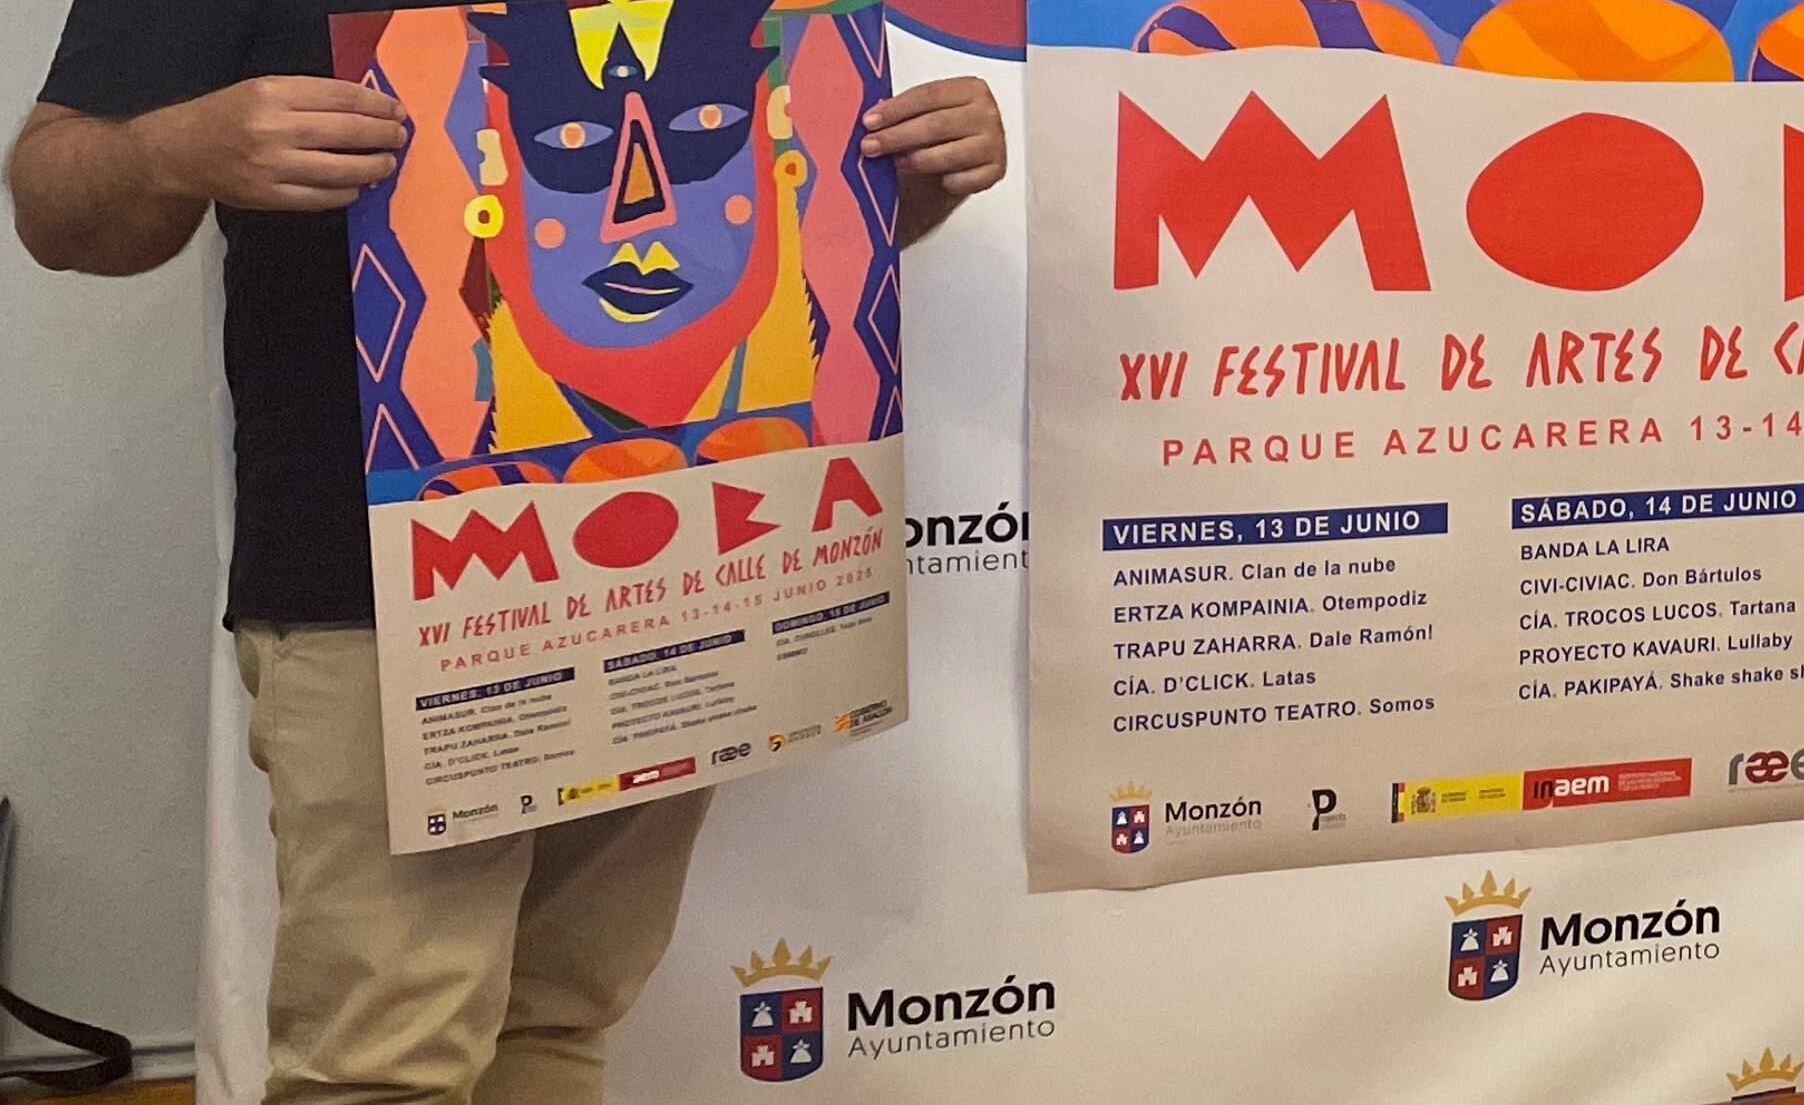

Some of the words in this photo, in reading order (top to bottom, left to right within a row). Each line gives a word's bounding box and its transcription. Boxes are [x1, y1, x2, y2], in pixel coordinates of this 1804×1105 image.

[1120, 351, 1188, 401] XVI
[1212, 337, 1406, 398] FESTIVAL
[1441, 334, 1492, 391] DE
[1526, 327, 1662, 388] ARTES
[1700, 326, 1748, 381] DE
[1163, 431, 1354, 467] PARQUE
[1383, 417, 1662, 456] AZUCARERA
[1521, 498, 1633, 523] SÁBADO,
[1646, 496, 1671, 515] 14
[1682, 494, 1713, 514] DE
[1723, 489, 1796, 512] JUNIO
[905, 501, 1029, 548] onzó
[1113, 520, 1242, 545] VIERNES,
[1256, 519, 1283, 538] 13
[1296, 516, 1329, 536] DE
[1340, 510, 1419, 534] JUNIO
[1521, 541, 1589, 560] BANDA
[1595, 539, 1619, 556] LA
[1626, 537, 1669, 554] LIRA
[419, 622, 451, 647] XVI
[462, 601, 552, 640] FESTIVAL
[567, 593, 591, 620] DE
[605, 577, 667, 613] ARTES
[683, 570, 705, 596] DE
[715, 554, 766, 587] CALLE
[782, 548, 803, 575] DE
[812, 528, 883, 567] MONZÓN
[1113, 565, 1233, 586] ANIMASUR.
[1242, 563, 1286, 580] Clan
[1294, 561, 1317, 578] de
[1325, 560, 1340, 576] la
[1349, 557, 1395, 574] nube
[1520, 573, 1635, 595] CIVI-CIVIAC.
[1643, 572, 1678, 587] Don
[1685, 567, 1761, 584] Bártulos
[1114, 604, 1184, 623] ERTZA
[1191, 597, 1314, 619] KOMPAINIA.
[1322, 590, 1427, 612] Otempodiz
[1520, 609, 1557, 630] CÍA.
[1565, 607, 1645, 627] TROCOS
[1653, 602, 1722, 621] LUCOS.
[1730, 600, 1795, 616] Tartana
[1113, 640, 1185, 660] TRAPU
[1193, 634, 1301, 655] ZAHARRA.
[1310, 631, 1352, 648] Dale
[1360, 624, 1432, 645] Ramón!
[1520, 642, 1626, 665] PROYECTO
[1633, 636, 1720, 657] KAVAURI.
[1728, 632, 1792, 651] Lullaby
[1113, 675, 1155, 696] CÍA.
[1164, 672, 1254, 693] D'CLICK.
[1263, 671, 1316, 687] Latas
[1519, 679, 1556, 700] CÍA.
[1564, 671, 1662, 697] PAKIPAYÁ.
[1670, 671, 1724, 688] Shake
[1731, 667, 1783, 684] shake
[1113, 707, 1266, 732] CIRCUSPUNTO
[1274, 700, 1361, 721] TEATRO.
[1369, 698, 1434, 714] Somos
[1533, 775, 1610, 800] inaem
[1165, 796, 1262, 822] Monzón
[1540, 902, 1720, 950] Monzón
[1539, 941, 1720, 977] Ayuntamiento
[847, 977, 1055, 1031] Monzón
[849, 1019, 1055, 1059] Ayuntamiento
